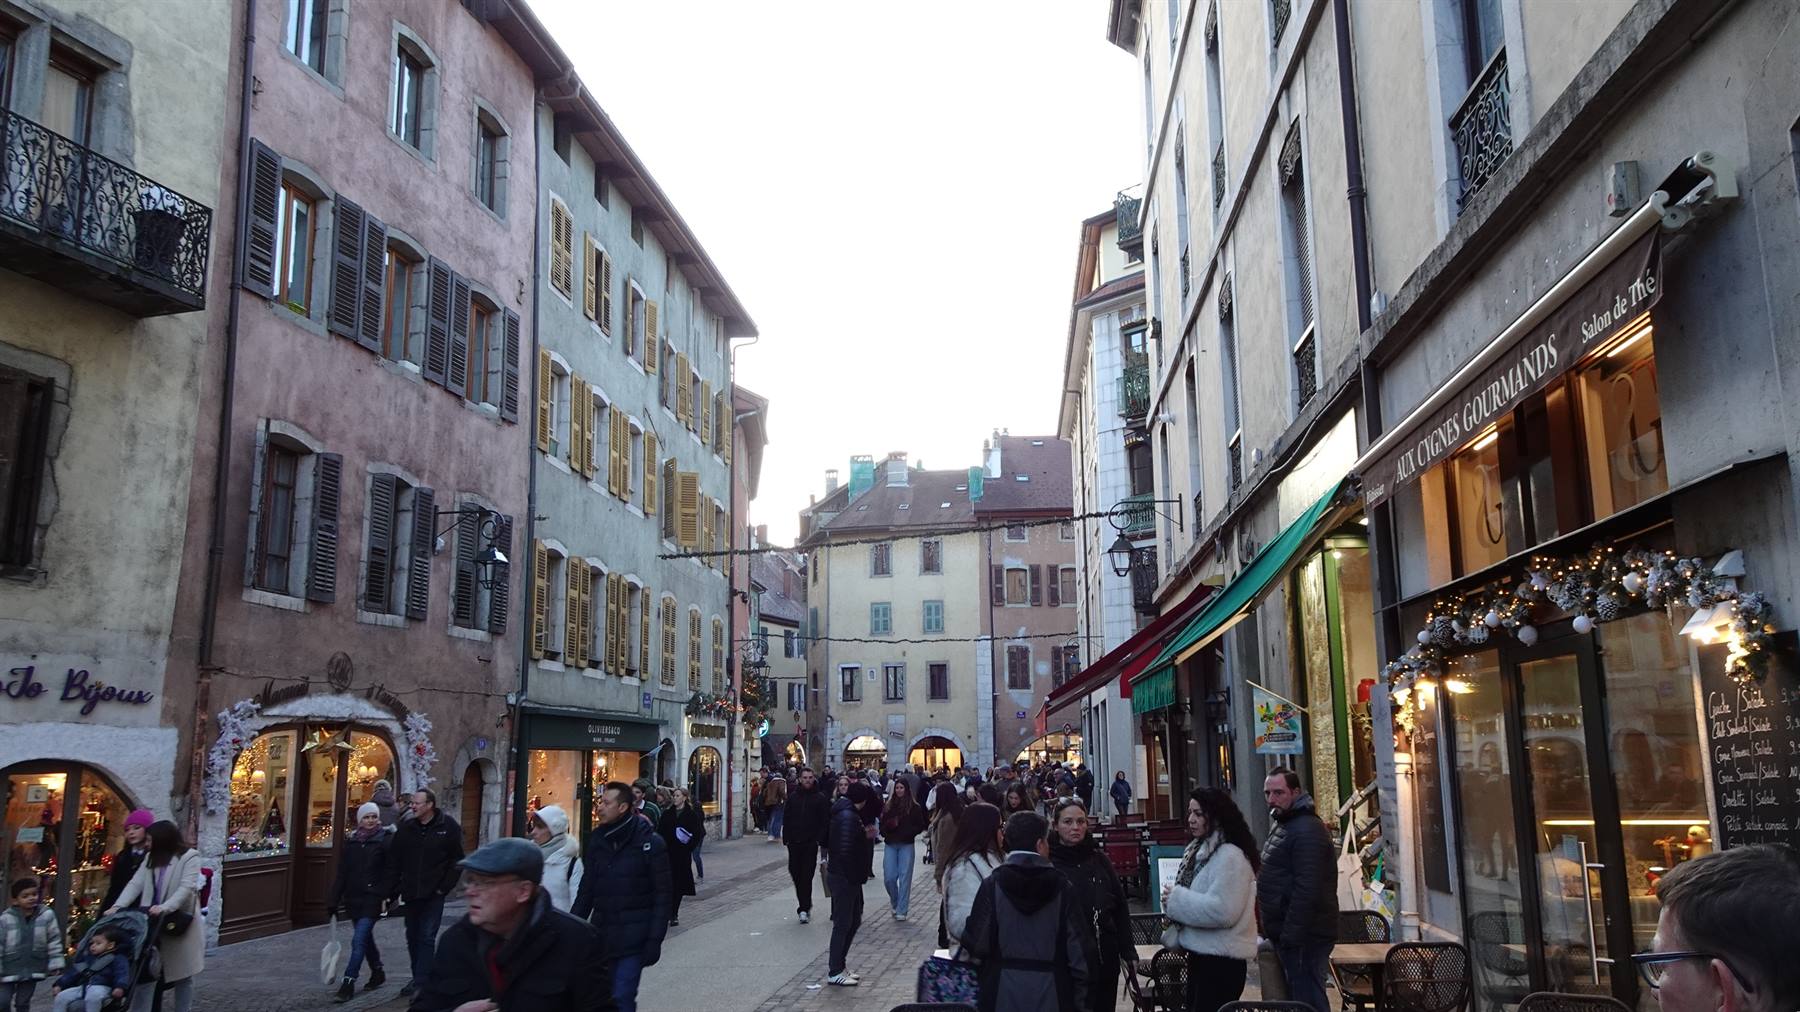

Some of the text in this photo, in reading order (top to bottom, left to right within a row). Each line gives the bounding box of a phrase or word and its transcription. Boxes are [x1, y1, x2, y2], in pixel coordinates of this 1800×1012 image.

[1581, 268, 1656, 343] Salon de Thé
[1396, 333, 1558, 483] AUX CYGNES GOURMANDS
[0, 665, 154, 715] Jo Bijoux
